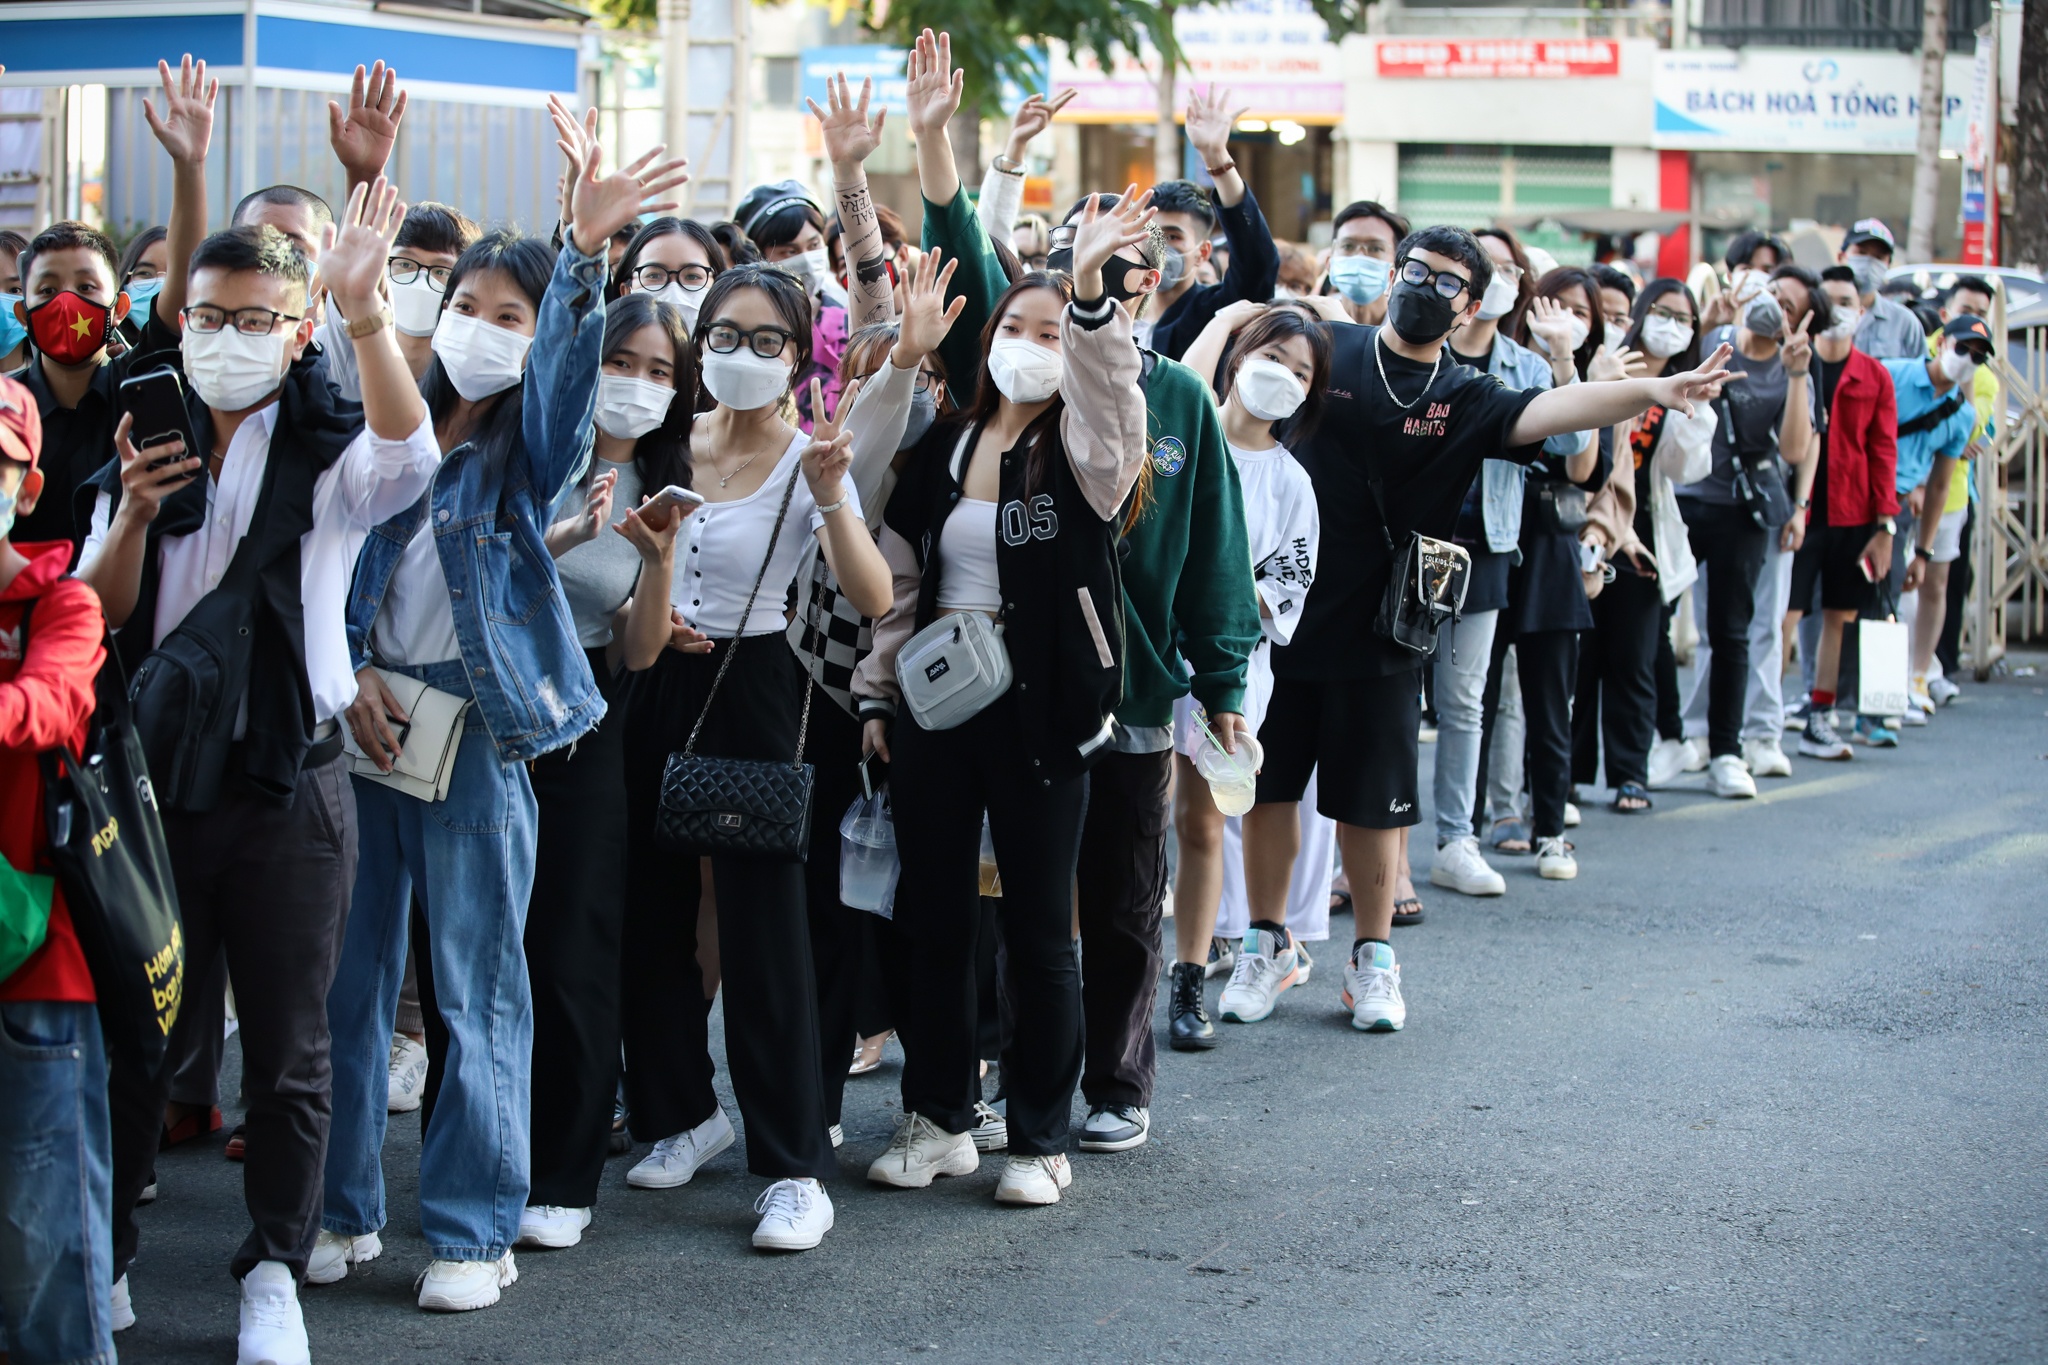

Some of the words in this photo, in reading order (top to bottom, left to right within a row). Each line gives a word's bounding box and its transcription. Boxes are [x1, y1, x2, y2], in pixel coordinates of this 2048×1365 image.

[1686, 86, 1756, 114] BÁCH
[1829, 80, 1898, 118] TỔNG
[1908, 93, 1963, 120] HP
[1426, 402, 1451, 419] BAD
[1403, 417, 1446, 436] HABITS
[1156, 440, 1173, 453] WHO
[1170, 450, 1184, 463] RUN
[1002, 493, 1059, 547] OS
[1292, 537, 1313, 589] HADES
